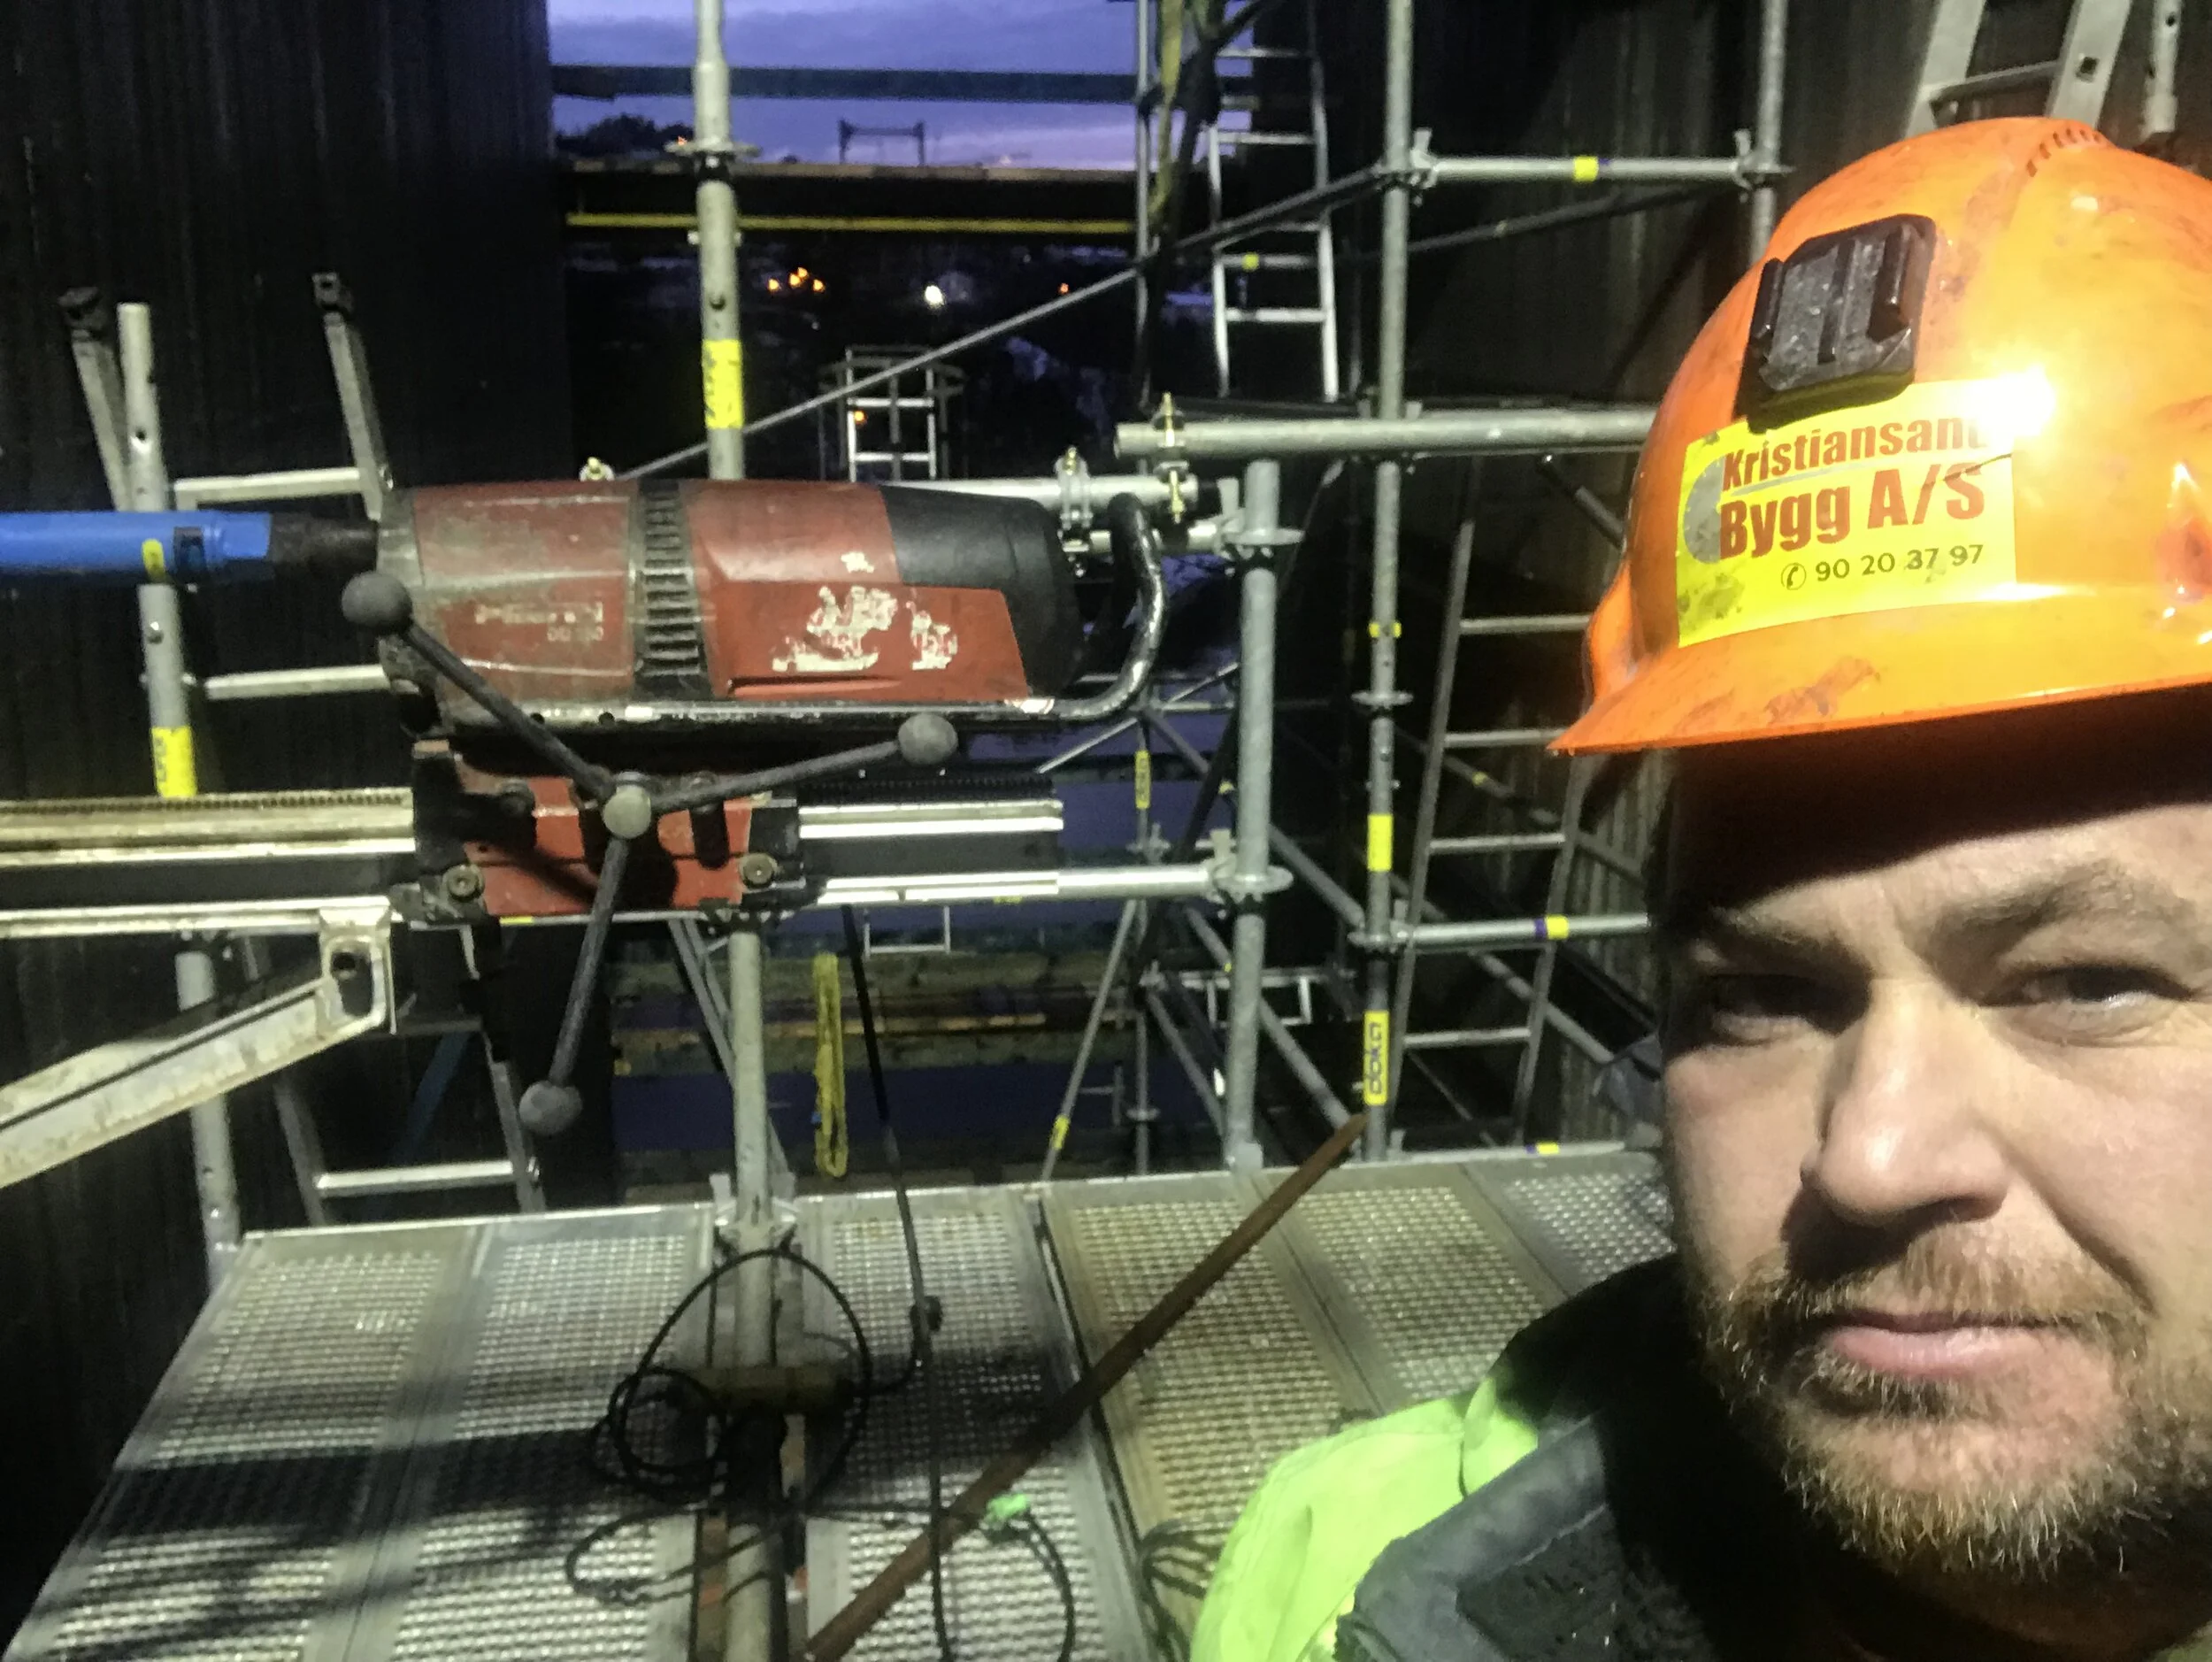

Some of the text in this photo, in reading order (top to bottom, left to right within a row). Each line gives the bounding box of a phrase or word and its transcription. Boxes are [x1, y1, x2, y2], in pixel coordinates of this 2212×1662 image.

[1720, 462, 1985, 560] Bygg A/S
[1816, 544, 1984, 581] 90 20 37 97
